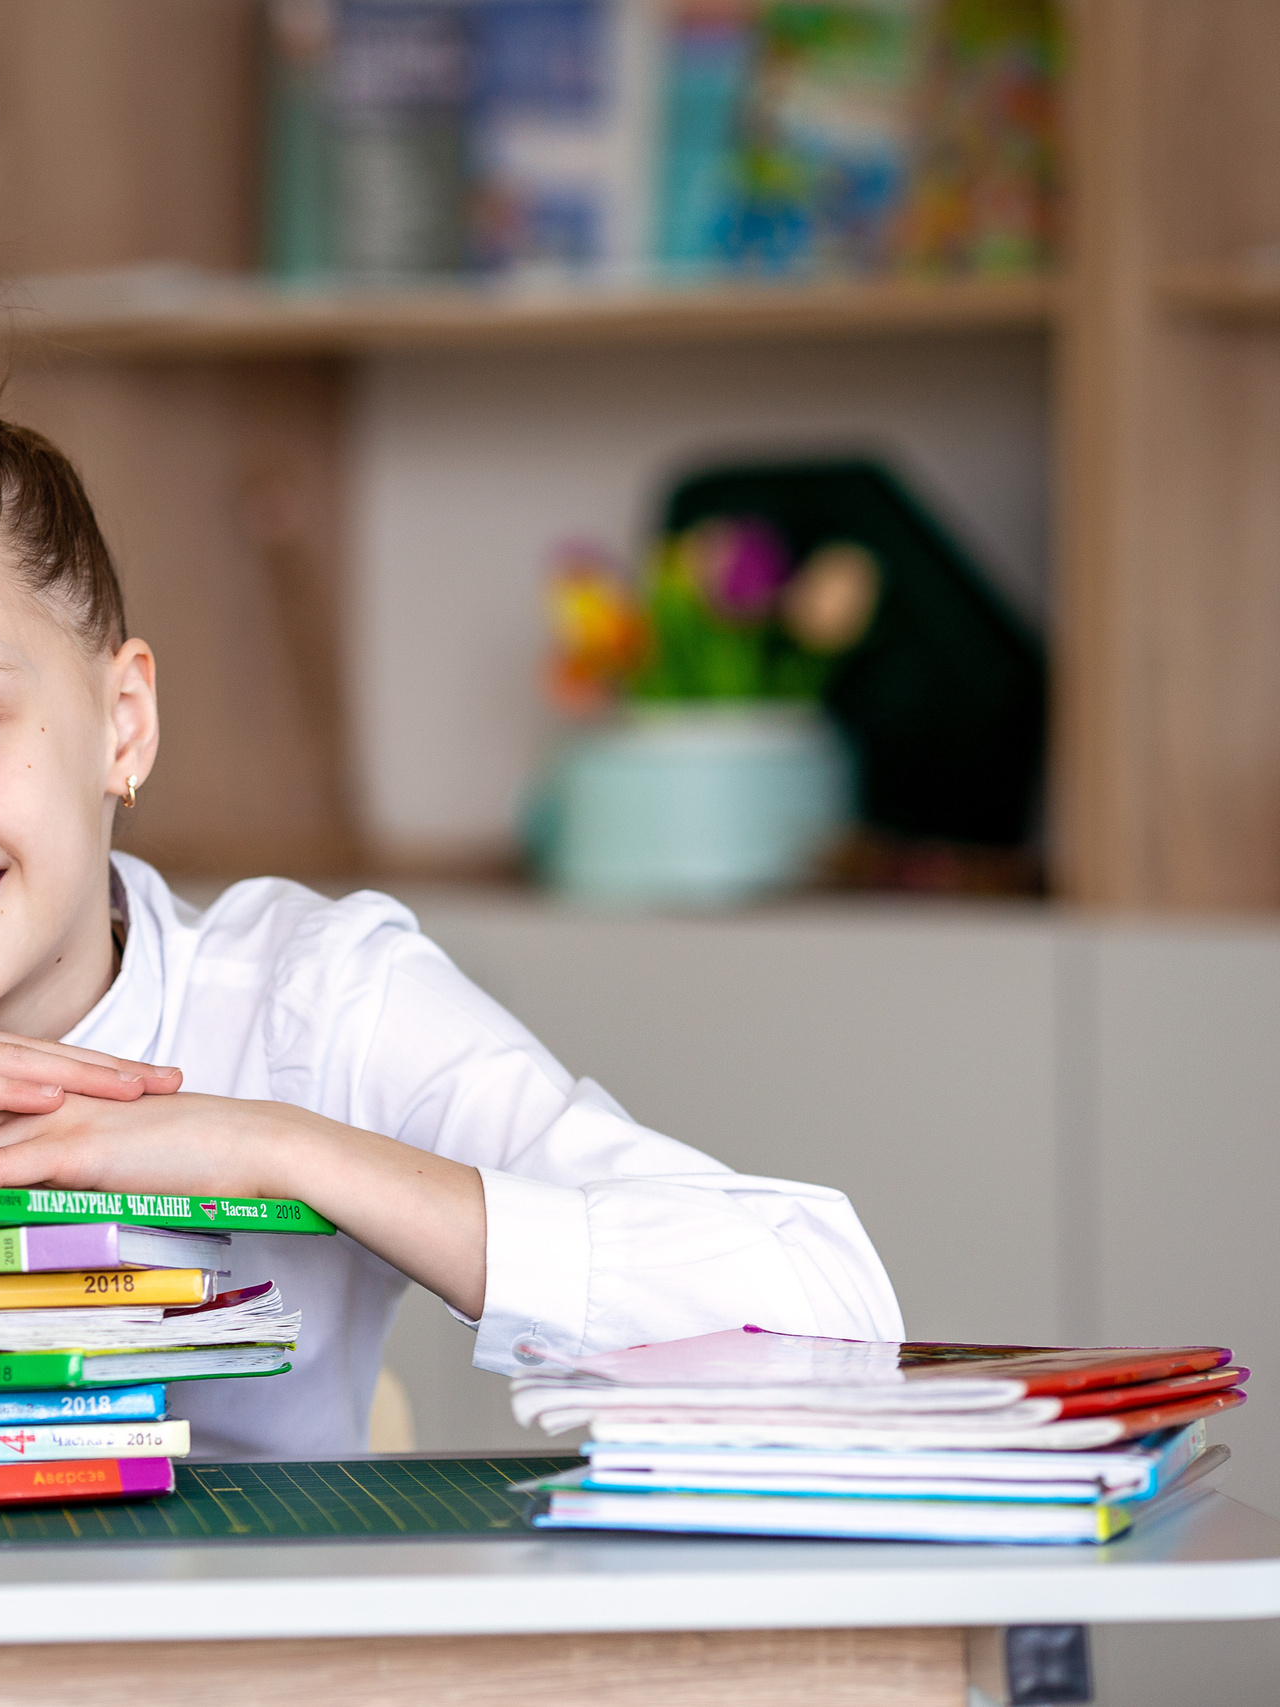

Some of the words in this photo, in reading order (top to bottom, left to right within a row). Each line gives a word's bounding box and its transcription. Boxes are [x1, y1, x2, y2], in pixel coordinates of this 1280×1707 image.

[27, 1190, 123, 1215] ЛІТАРАТУРНАЕ
[126, 1195, 192, 1217] ЧЫТАННЕ
[200, 1200, 217, 1220] 4
[220, 1201, 259, 1217] Частка
[261, 1203, 268, 1218] 2
[275, 1204, 301, 1220] 2018
[4, 1237, 16, 1265] 2018
[84, 1274, 135, 1294] 2018
[61, 1395, 111, 1415] 2018
[127, 1432, 163, 1446] 2018
